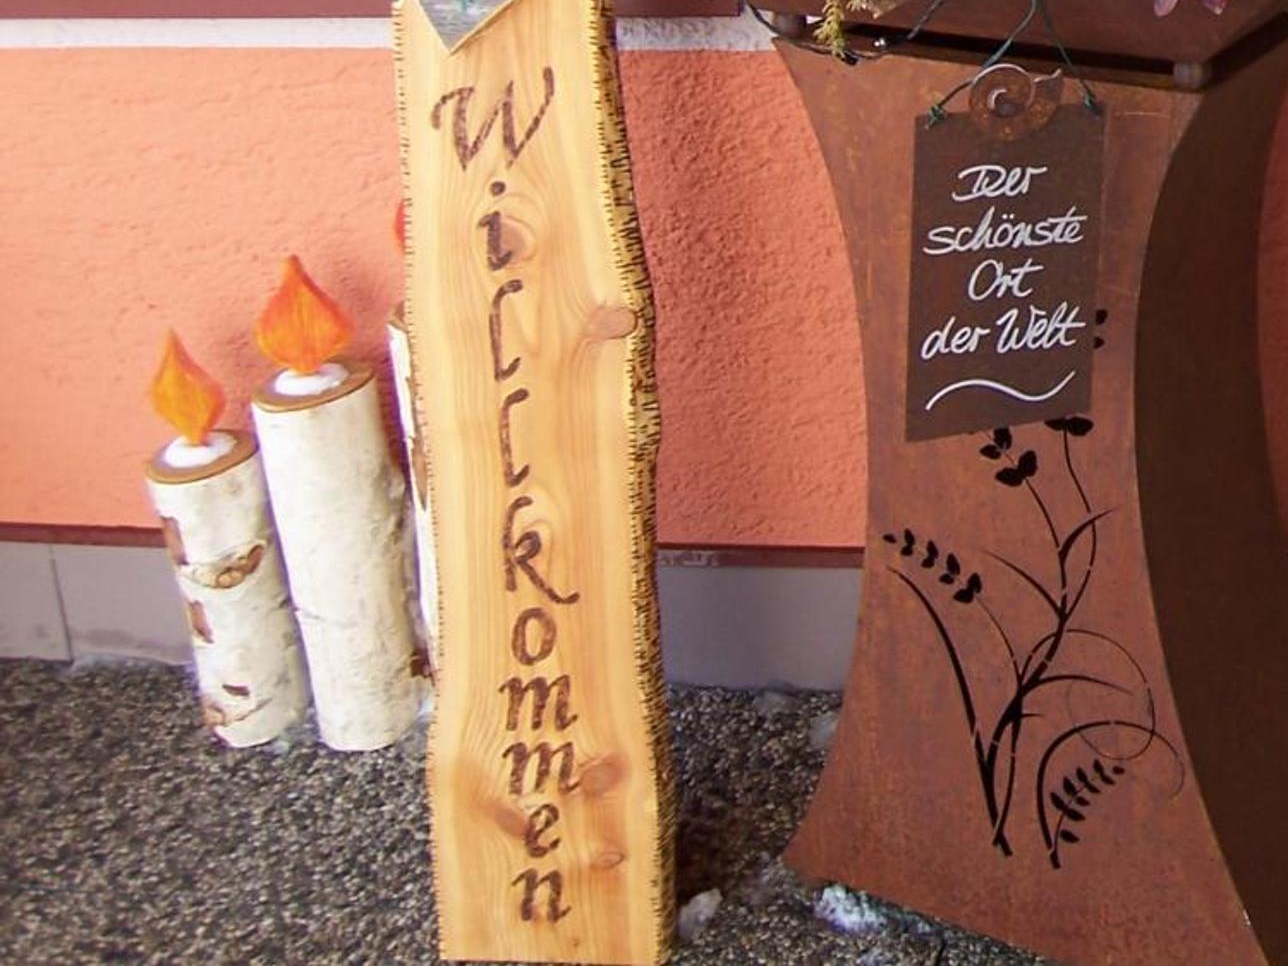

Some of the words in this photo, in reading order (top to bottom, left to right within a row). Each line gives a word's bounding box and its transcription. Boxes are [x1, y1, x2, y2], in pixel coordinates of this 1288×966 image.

[952, 165, 1048, 202] Der
[923, 206, 1088, 254] schönste
[968, 258, 1044, 301] Ort
[921, 316, 990, 359] der
[996, 301, 1086, 353] Welt
[431, 66, 580, 922] Willkommen
